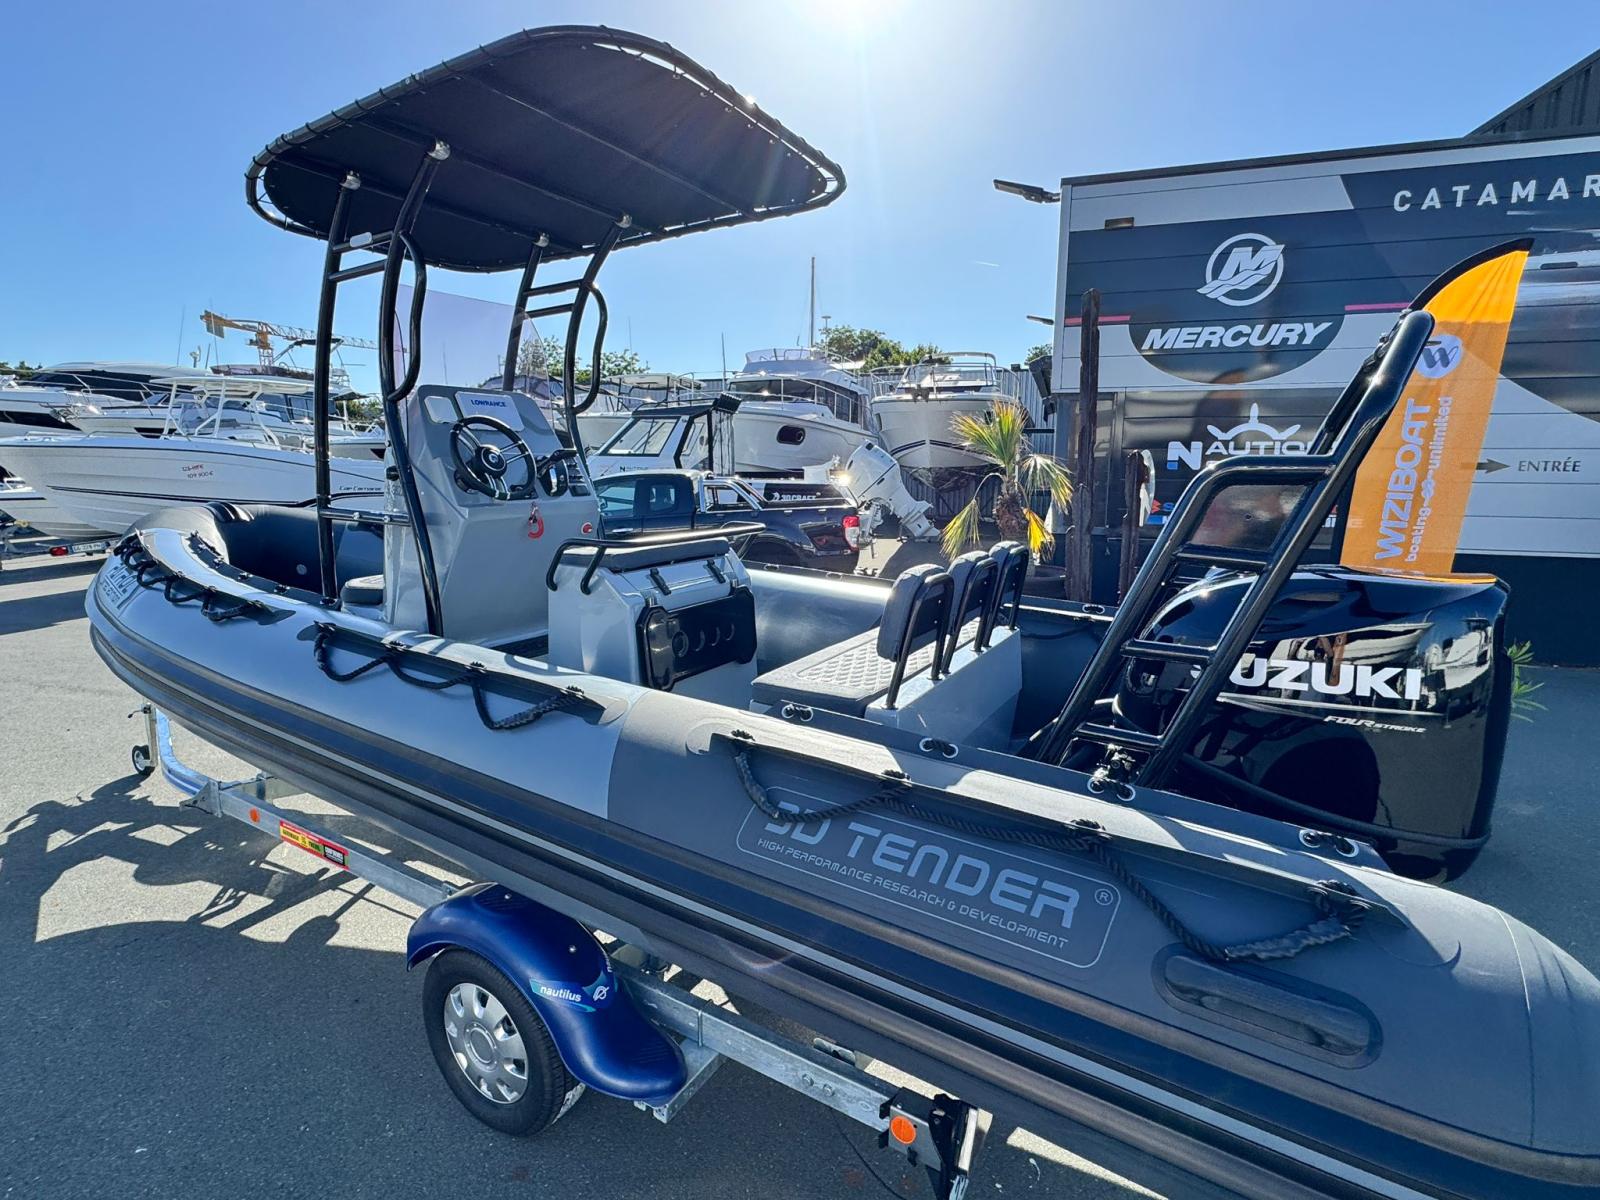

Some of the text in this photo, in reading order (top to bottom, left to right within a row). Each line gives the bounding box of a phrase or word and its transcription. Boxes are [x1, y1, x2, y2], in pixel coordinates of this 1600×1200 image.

[1393, 174, 1600, 213] CATAMAR
[1141, 322, 1333, 350] MERCURY
[470, 399, 507, 408] LOWRANCE
[1374, 397, 1431, 561] WIZIBOAT
[1518, 456, 1582, 473] ENTRÉE
[1190, 653, 1422, 700] UZUKI
[757, 838, 1069, 949] HIGH PERFORMANCE RESEARCH & DEVELOPMENT
[847, 822, 1080, 929] TENDER
[540, 985, 582, 1003] nautilus
